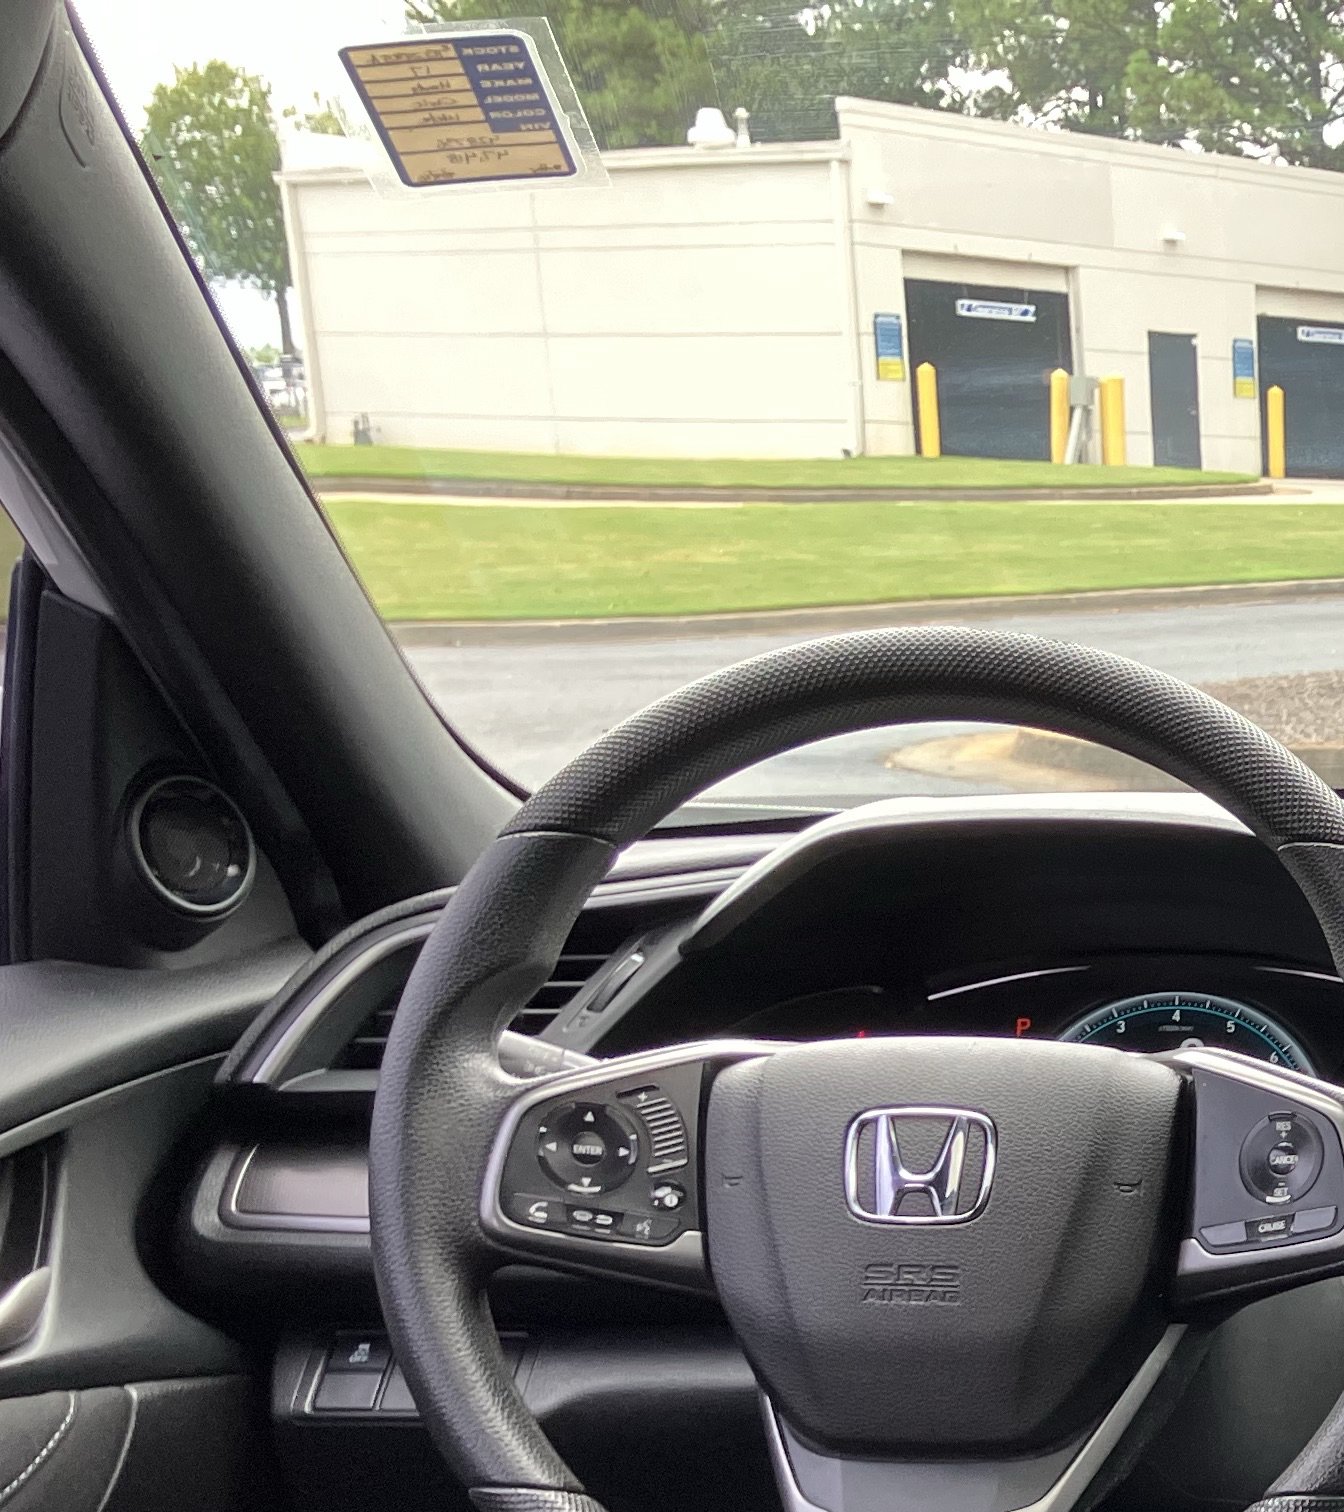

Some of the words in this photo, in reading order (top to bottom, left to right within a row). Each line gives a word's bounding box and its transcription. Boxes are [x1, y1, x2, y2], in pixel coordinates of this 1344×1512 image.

[1172, 1010, 1181, 1023] 4
[1015, 1018, 1032, 1037] P
[1116, 1021, 1126, 1034] 3
[1226, 1021, 1236, 1034] 5
[1269, 1052, 1279, 1065] 6
[1275, 1121, 1292, 1131] RES
[573, 1144, 603, 1155] ENTER
[1272, 1187, 1289, 1197] SET
[864, 1263, 960, 1284] SRS
[862, 1287, 961, 1304] AIRBAG
